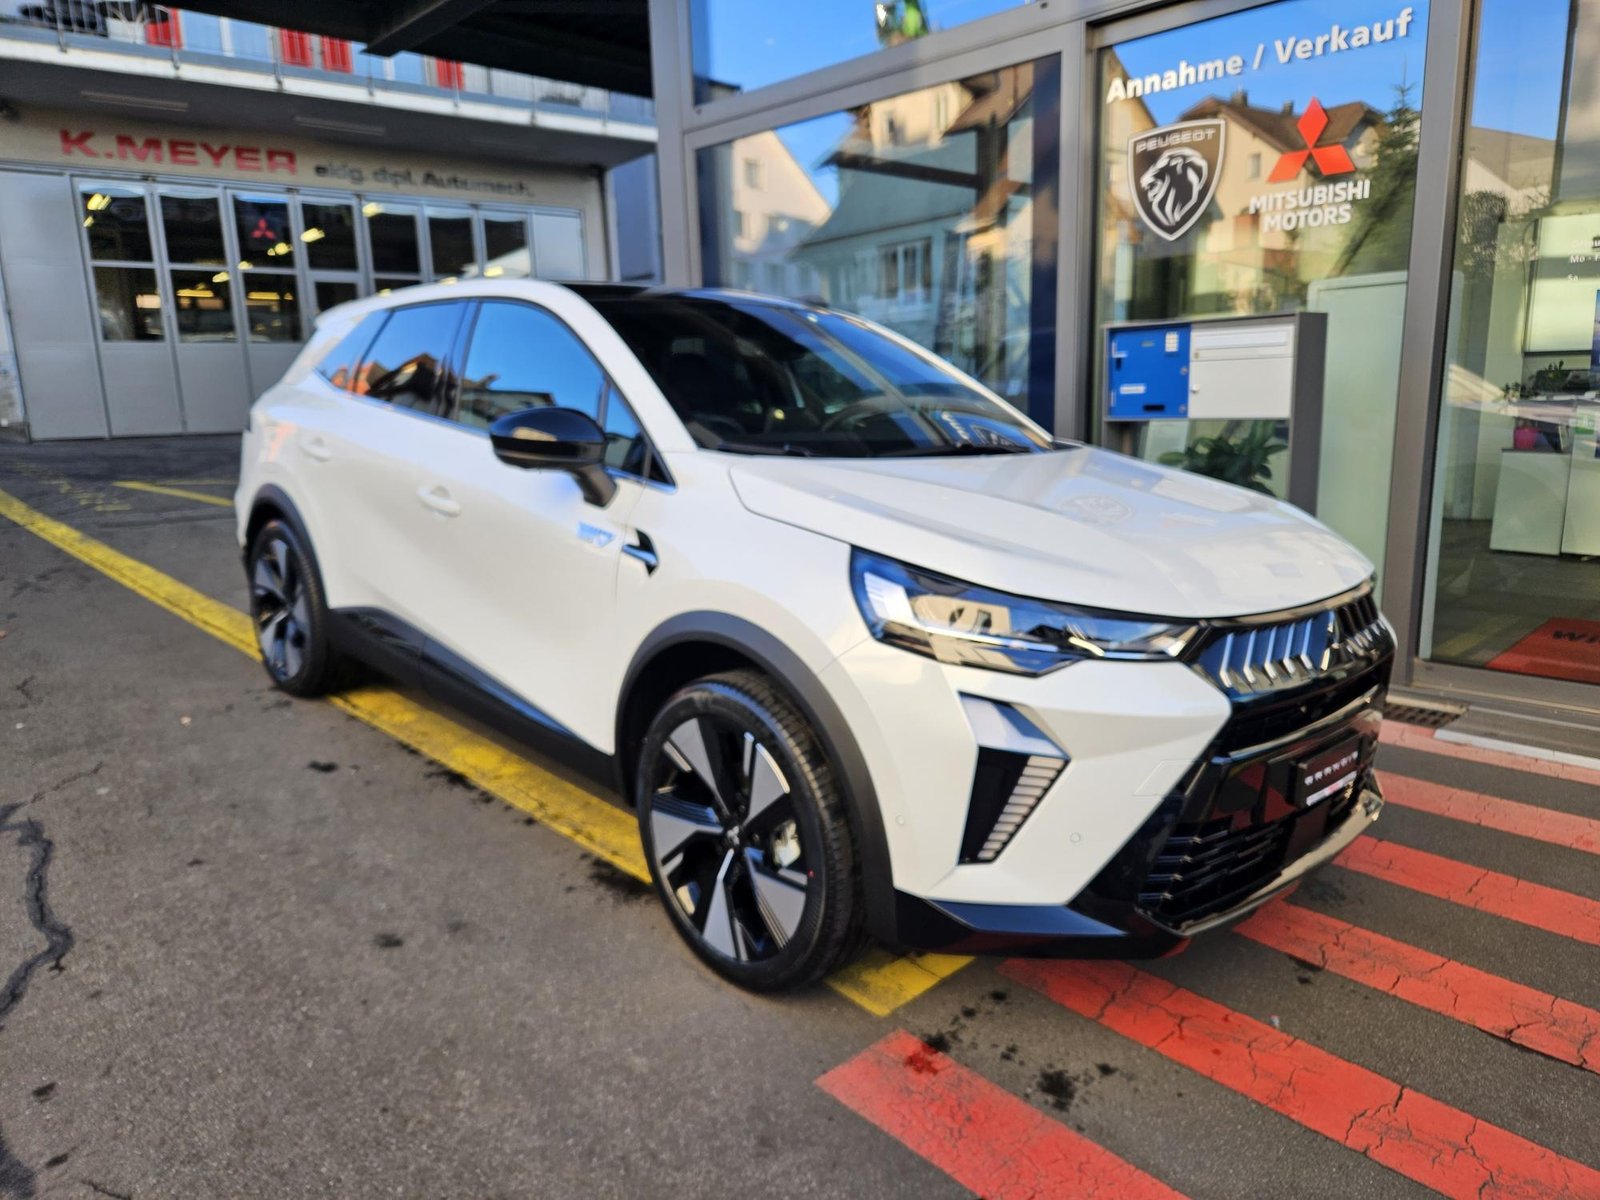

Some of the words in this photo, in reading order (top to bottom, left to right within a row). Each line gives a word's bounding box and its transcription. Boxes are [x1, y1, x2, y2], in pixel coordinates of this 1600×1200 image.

[1105, 54, 1244, 103] Annahme
[1252, 43, 1265, 71] /
[1274, 7, 1413, 64] Verkauf
[1135, 128, 1217, 153] PEUGEOT
[1248, 179, 1371, 215] MITSUBISHI
[1263, 203, 1353, 233] MOTORS
